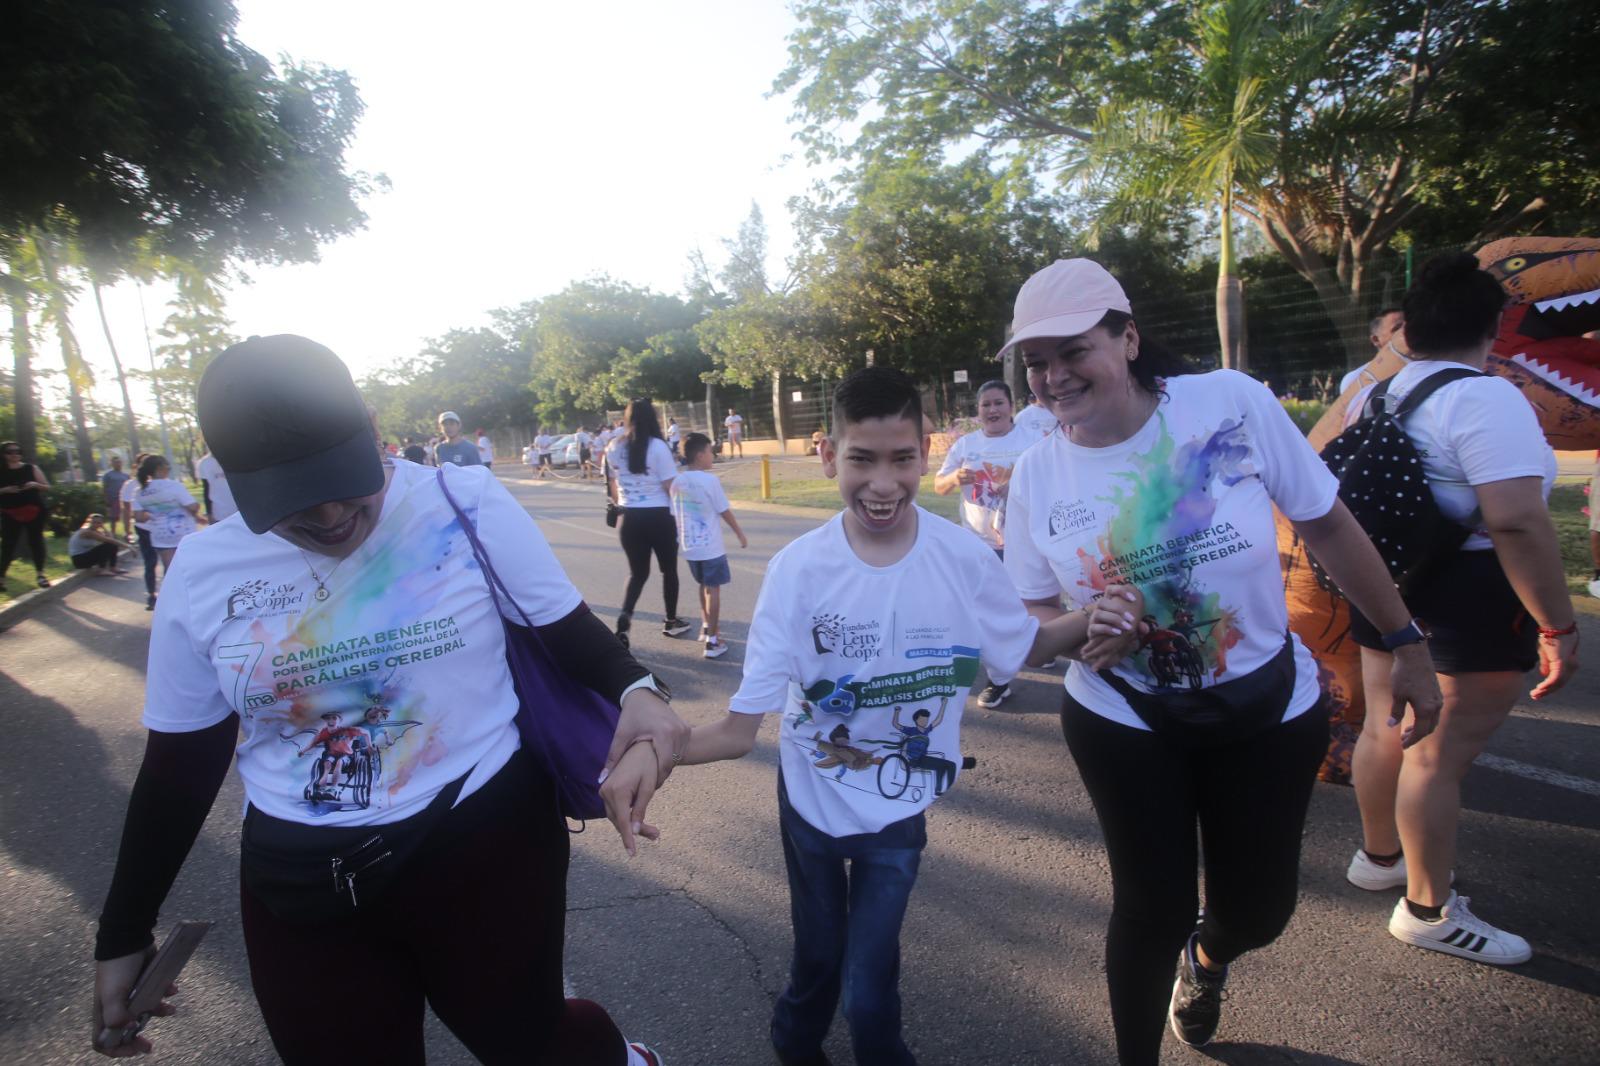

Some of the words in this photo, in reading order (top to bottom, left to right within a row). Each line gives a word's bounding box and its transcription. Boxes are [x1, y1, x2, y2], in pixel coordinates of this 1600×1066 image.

[1099, 544, 1165, 572] CAMINATA
[1166, 522, 1235, 550] BENÉFICA
[1103, 569, 1119, 580] POR
[1119, 566, 1130, 575] EL
[1146, 540, 1217, 564] INTERNACIONAL
[1217, 535, 1230, 545] DE
[1230, 531, 1241, 540] LA
[1180, 539, 1253, 569] CEREBRAL
[253, 592, 304, 609] Coppel
[272, 635, 371, 667] CAMINATA
[374, 616, 456, 644] BENÉFICA
[272, 666, 299, 679] POR
[301, 662, 317, 672] EL
[318, 655, 339, 668] DÍA
[341, 635, 435, 661] INTERNACIONAL
[436, 631, 449, 641] DE
[449, 627, 460, 637] LA
[276, 660, 380, 693] PARÁLISIS
[384, 638, 466, 668] CEREBRAL
[218, 641, 265, 718] 7
[915, 666, 956, 681] BENÉFIC
[915, 684, 957, 698] CEREBRA
[247, 694, 275, 709] ma
